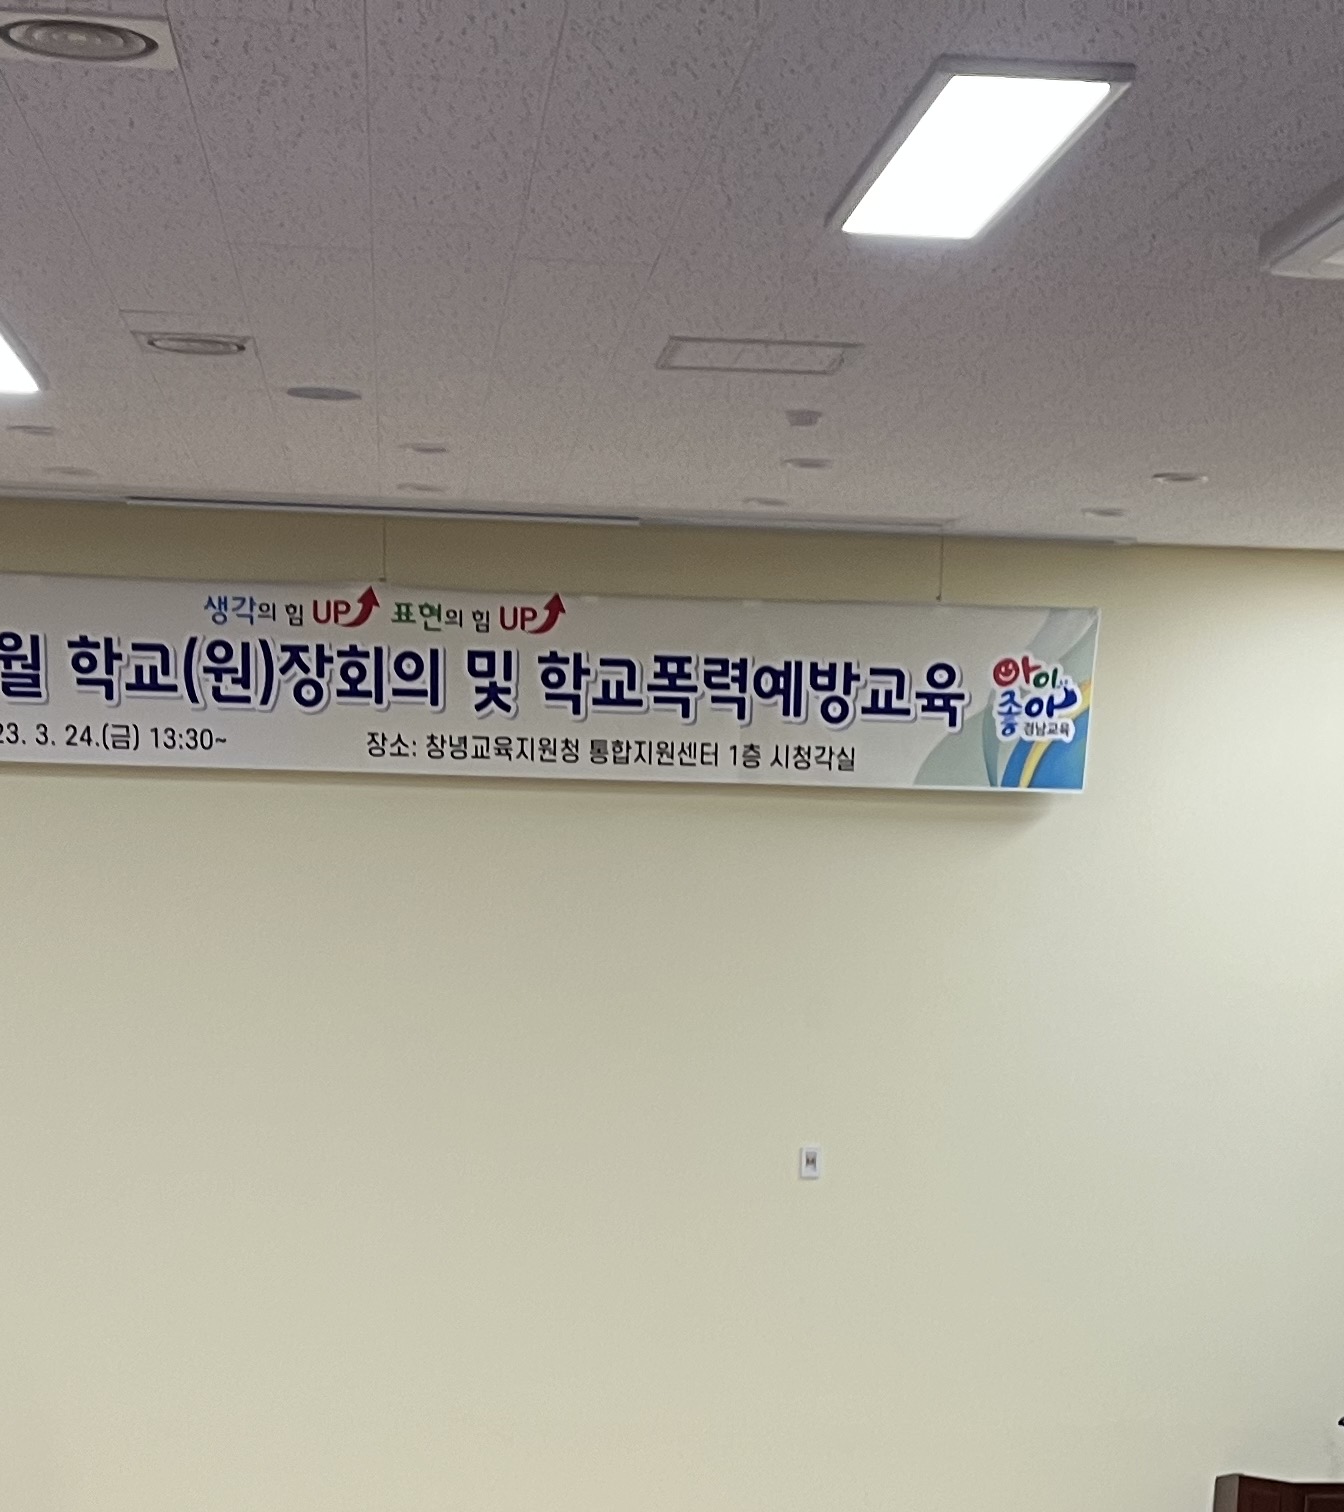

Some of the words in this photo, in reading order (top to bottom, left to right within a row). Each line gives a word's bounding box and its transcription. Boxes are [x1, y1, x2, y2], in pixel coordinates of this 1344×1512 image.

[204, 595, 276, 626] 생각의
[285, 603, 303, 626] 힘
[312, 599, 352, 625] UP
[391, 602, 463, 631] 표현의
[472, 609, 490, 633] 힘
[499, 606, 538, 631] UP
[66, 634, 440, 708] 학교(원)장회의
[466, 649, 513, 713] 및
[537, 649, 965, 728] 학교폭력예방교육
[993, 655, 1059, 690] 아이
[34, 723, 56, 747] 3.
[64, 723, 140, 751] 24.(금)
[149, 726, 228, 750] 13:30~
[366, 731, 417, 758] 장소:
[425, 733, 580, 764] 창녕교육지원청
[589, 738, 719, 767] 통합지원센터
[729, 743, 762, 769] 1층
[769, 744, 855, 771] 시청각실
